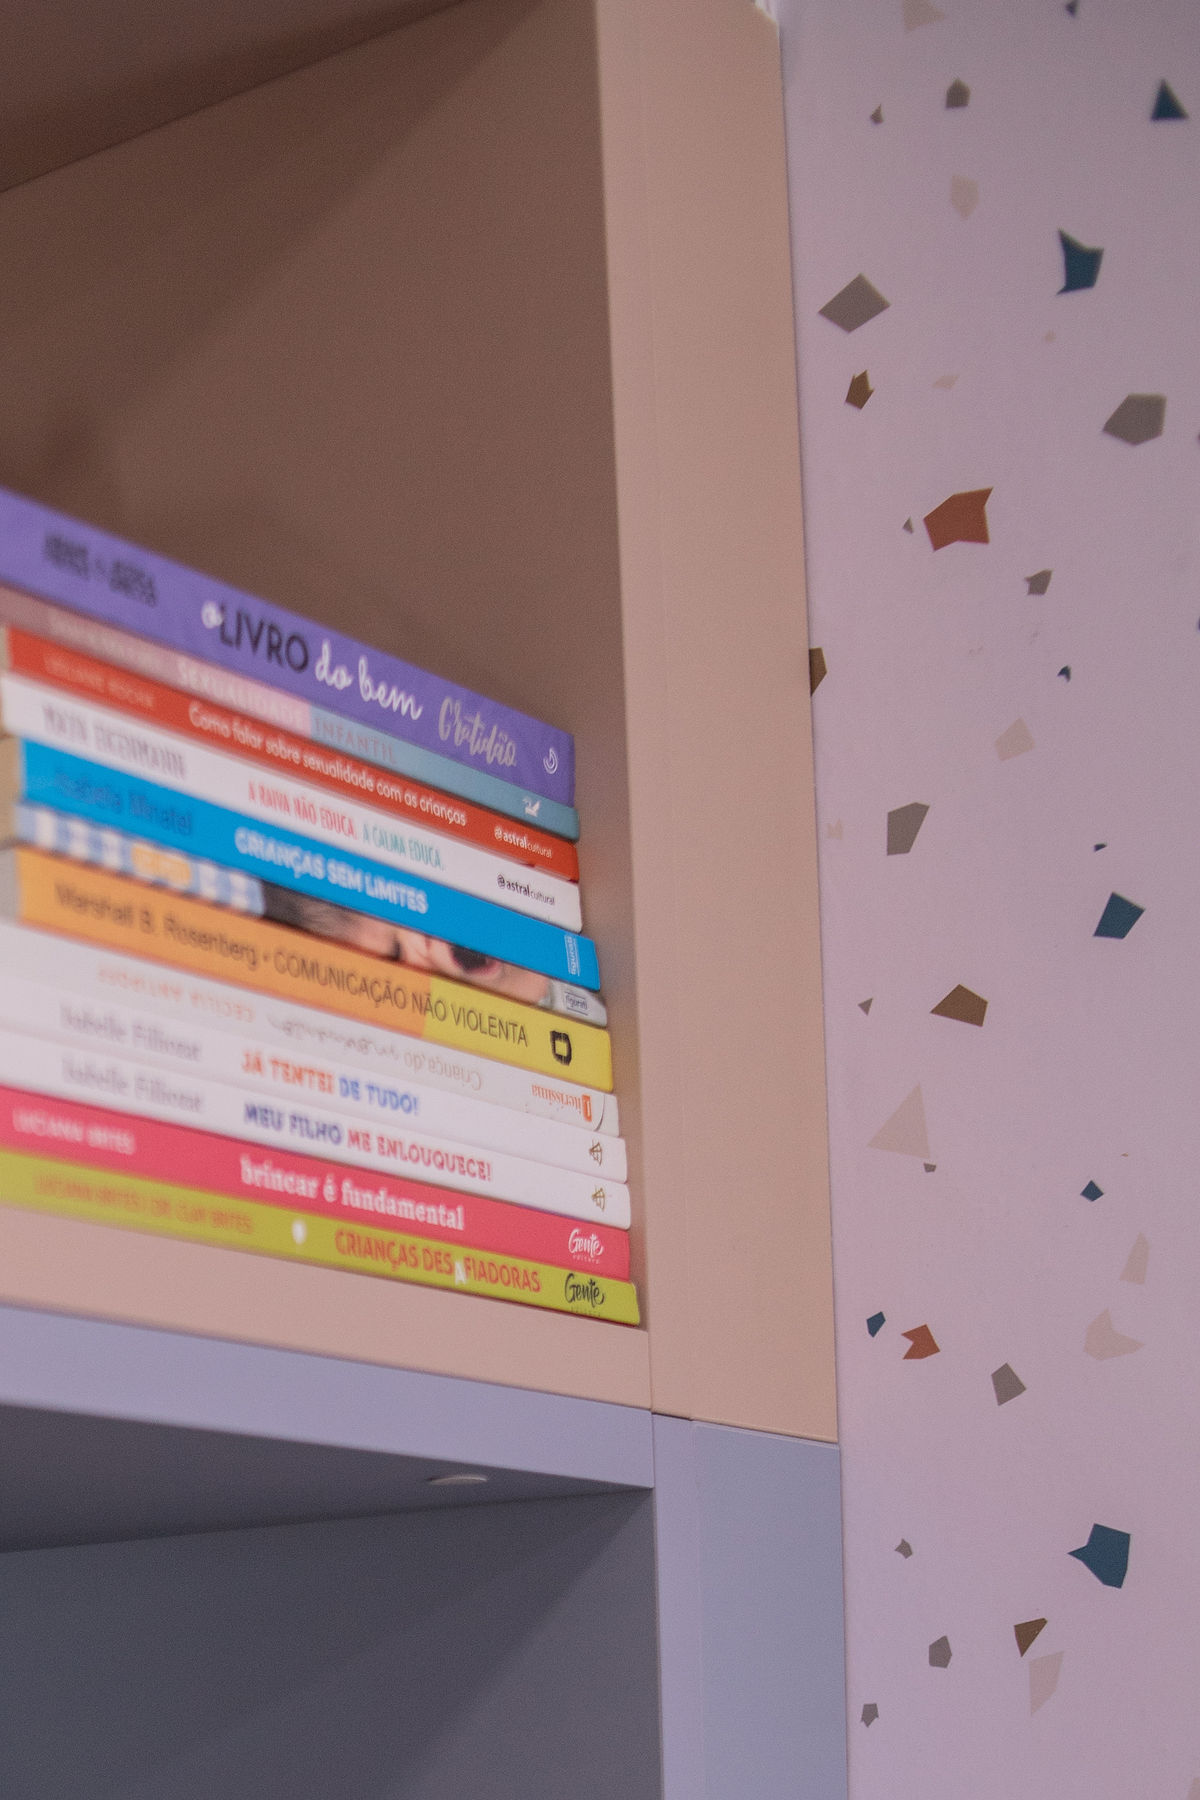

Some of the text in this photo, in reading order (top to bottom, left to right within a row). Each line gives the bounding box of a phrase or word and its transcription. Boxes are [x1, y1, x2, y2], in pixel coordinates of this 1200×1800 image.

[219, 600, 310, 674] LIVRO
[315, 639, 352, 691] do
[358, 655, 422, 721] bem
[438, 696, 517, 768] Gratidão
[189, 701, 467, 827] Como falar sobre sexualidade com as crianças
[248, 780, 255, 802] A
[259, 783, 290, 816] RAIVA
[294, 793, 318, 824] NÃO
[362, 823, 370, 844] A
[372, 828, 405, 858] CALMA
[234, 826, 325, 878] CRIANÇAS
[326, 857, 363, 893] SEM
[365, 871, 430, 915] LIMITES
[162, 914, 258, 972] Rosenberg
[273, 951, 408, 1011] COMUNICAÇÃO
[411, 990, 447, 1022] NÃO
[451, 1006, 529, 1048] VIOLENTA
[269, 1057, 336, 1095] TENTEI
[338, 1073, 361, 1100] DE
[365, 1083, 420, 1116] TUDO!
[243, 1101, 492, 1183] MEU FILHO ME ENLOUQUECE!
[240, 1153, 465, 1232] brincar é fundamental
[334, 1229, 541, 1294] CRIANÇAS DESAFIADORAS
[568, 1228, 604, 1260] Gente
[564, 1272, 606, 1309] Gente
